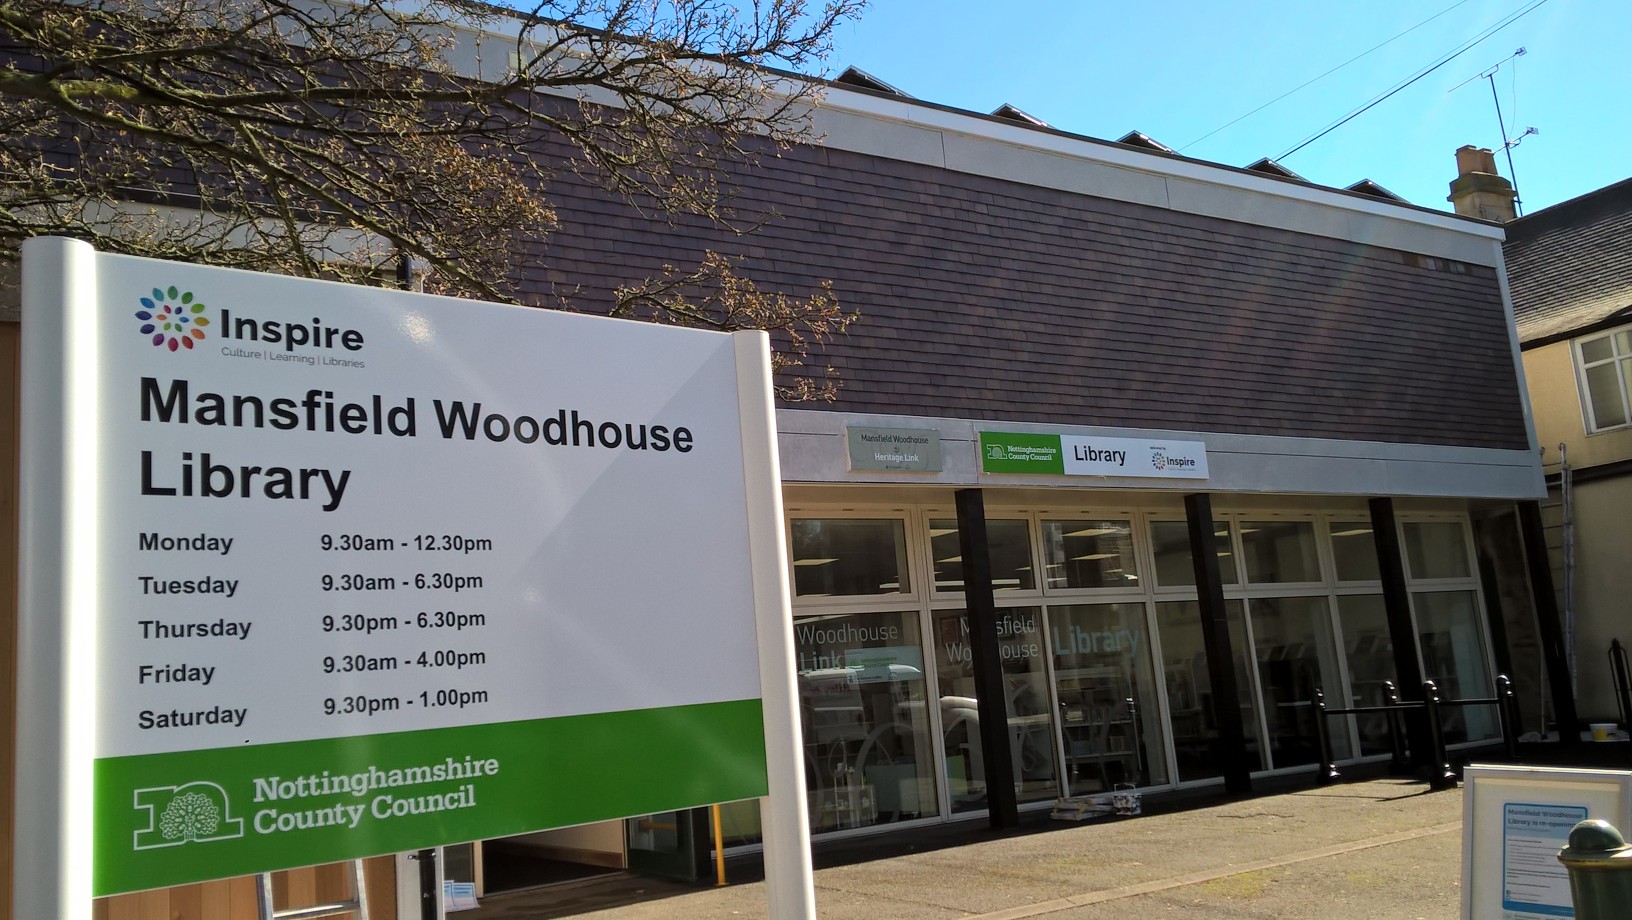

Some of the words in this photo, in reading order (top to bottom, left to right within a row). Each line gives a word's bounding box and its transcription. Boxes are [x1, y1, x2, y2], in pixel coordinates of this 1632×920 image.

[220, 309, 365, 352] Inspire
[221, 346, 262, 359] Culture
[269, 351, 315, 366] Learning
[323, 356, 365, 369] Libraries
[140, 377, 417, 437] Mansfield
[432, 399, 694, 453] Woodhouse
[861, 434, 892, 443] Mansfield
[893, 435, 929, 445] Woodhouse
[1007, 445, 1056, 454] Nottinghamshire
[874, 453, 903, 463] Heritage
[904, 454, 919, 462] Link
[1008, 453, 1029, 462] County
[1074, 445, 1126, 466] Library
[1166, 456, 1195, 468] Inspire
[140, 451, 351, 512] Library
[139, 532, 234, 555] Monday
[320, 534, 394, 551] 9.30am
[413, 535, 492, 554] 12.30pm
[138, 576, 239, 598] Tuesday
[321, 574, 395, 591] 9.30am
[414, 573, 483, 592] 6.30pm
[138, 619, 252, 640] Thursday
[322, 615, 397, 635] 9.30pm
[417, 612, 486, 631] 6.30pm
[796, 623, 898, 645] Woodhouse
[960, 615, 1036, 636] Msfield
[1053, 624, 1140, 657] Library
[799, 650, 841, 671] Link
[945, 642, 1038, 663] Woouse
[138, 664, 215, 686] Friday
[323, 656, 397, 673] 9.30am
[416, 650, 486, 669] 4.00pm
[138, 706, 247, 730] Saturday
[323, 695, 399, 715] 9.30pm
[419, 689, 489, 709] 1.00pm
[253, 755, 500, 803] Nottinghamshire
[253, 803, 365, 834] County
[370, 785, 477, 819] Council
[1508, 808, 1540, 817] Mansfield
[1508, 818, 1530, 826] Library
